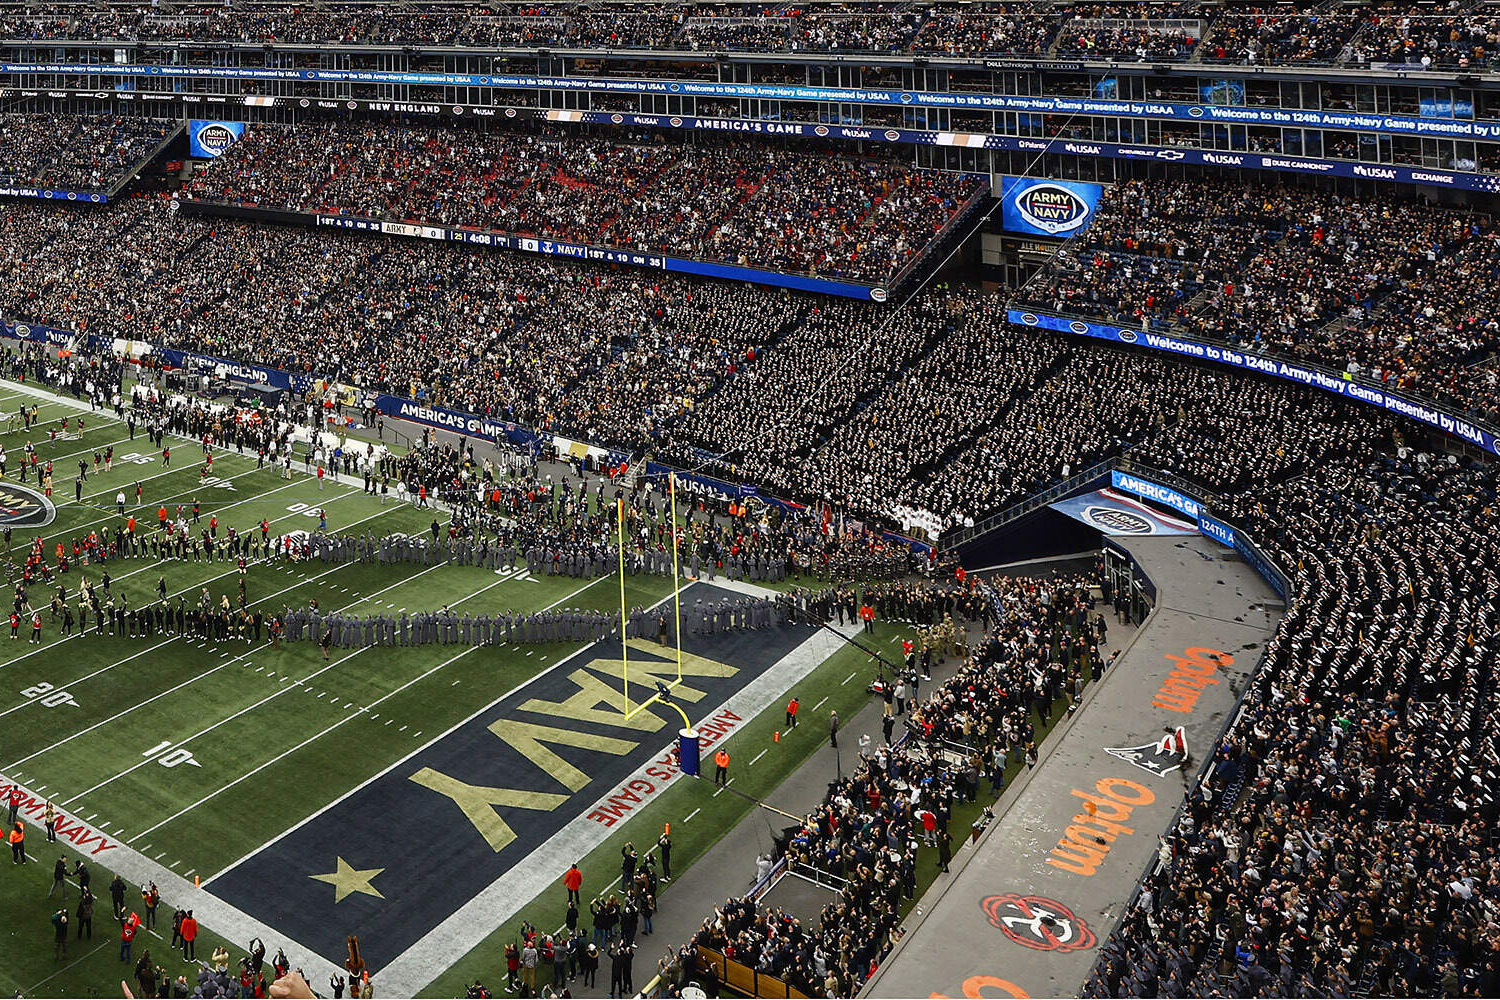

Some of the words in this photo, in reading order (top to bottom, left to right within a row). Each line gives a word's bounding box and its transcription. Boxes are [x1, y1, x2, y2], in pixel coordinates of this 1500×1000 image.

[757, 88, 795, 96] Army-Navy
[819, 92, 855, 100] presented
[857, 92, 866, 100] by
[395, 105, 439, 113] ENGLAND
[918, 95, 955, 103] Welcome
[1007, 99, 1054, 109] Army-Navy
[1055, 100, 1082, 109] Game
[1132, 105, 1143, 113] by
[1146, 106, 1173, 114] USAA
[695, 118, 764, 131] AMERICA'S
[767, 124, 802, 133] GAME
[1211, 109, 1258, 119] Welcome
[1274, 112, 1290, 120] the
[1292, 113, 1320, 122] 124th
[1323, 116, 1382, 127] Army-Navy
[1385, 119, 1415, 129] Game
[1418, 120, 1473, 133] presented
[1474, 125, 1488, 136] by
[206, 129, 226, 137] ARMY
[207, 139, 226, 147] NAVY
[1077, 146, 1099, 154] USAA
[1216, 156, 1242, 164] USAA
[1368, 168, 1394, 178] USAA
[1412, 173, 1453, 183] EXCHANGE
[1032, 192, 1070, 205] ARMY
[1034, 207, 1069, 219] NAVY
[321, 217, 334, 225] 1ST
[386, 224, 406, 233] ARMY
[454, 232, 462, 240] 25
[469, 233, 491, 244] 4:08
[557, 244, 583, 255] NAVY
[589, 250, 605, 259] 1ST
[617, 254, 628, 262] 10
[633, 256, 645, 264] ON
[650, 258, 660, 266] 35
[1021, 242, 1033, 250] ALE
[1145, 334, 1203, 355] Welcome
[1206, 344, 1220, 358] to
[1222, 348, 1242, 364] the
[1245, 354, 1277, 373] 124th
[1279, 364, 1346, 392] Army-Navy
[1347, 384, 1383, 404] Game
[1385, 394, 1438, 427] presented
[1441, 415, 1454, 431] by
[1455, 421, 1484, 445] USAA
[400, 402, 465, 431] AMERICA'S
[467, 417, 505, 437] GAME
[1119, 476, 1184, 509] AMERICA'S
[1094, 515, 1133, 530] NAVY
[1107, 511, 1148, 527] ARMY
[1201, 519, 1226, 539] 124TH
[1151, 646, 1235, 714] Optum
[19, 682, 75, 708] 20
[408, 638, 741, 854] NAVY
[646, 709, 743, 781] AMERA'S
[142, 741, 193, 768] 10
[586, 778, 656, 828] GAME
[1045, 777, 1156, 877] Optum
